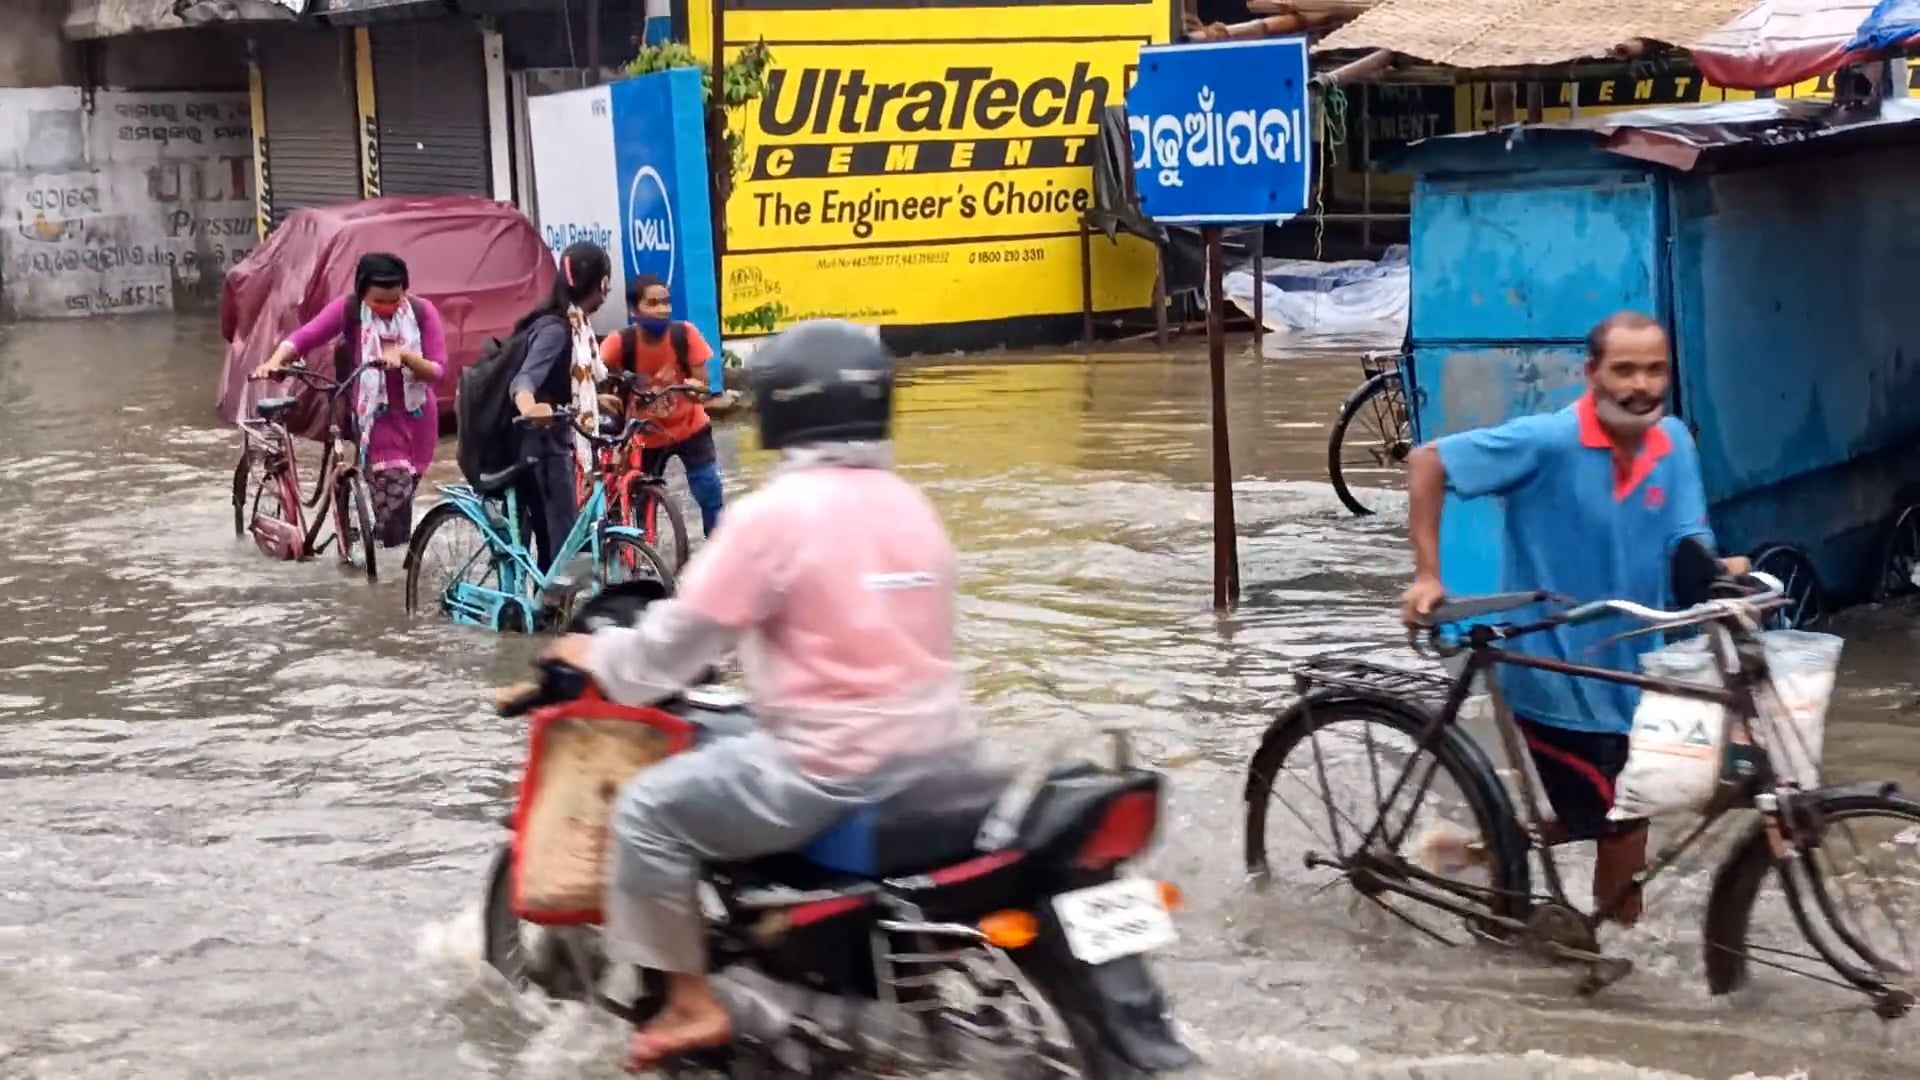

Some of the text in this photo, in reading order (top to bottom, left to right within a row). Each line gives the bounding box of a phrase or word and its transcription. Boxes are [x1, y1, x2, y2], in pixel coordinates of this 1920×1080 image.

[757, 61, 1110, 136] UltraTech
[766, 138, 1086, 176] CEMENT
[753, 179, 1089, 239] The Engineer's Choice
[546, 223, 566, 251] Dell
[634, 217, 670, 251] DELL
